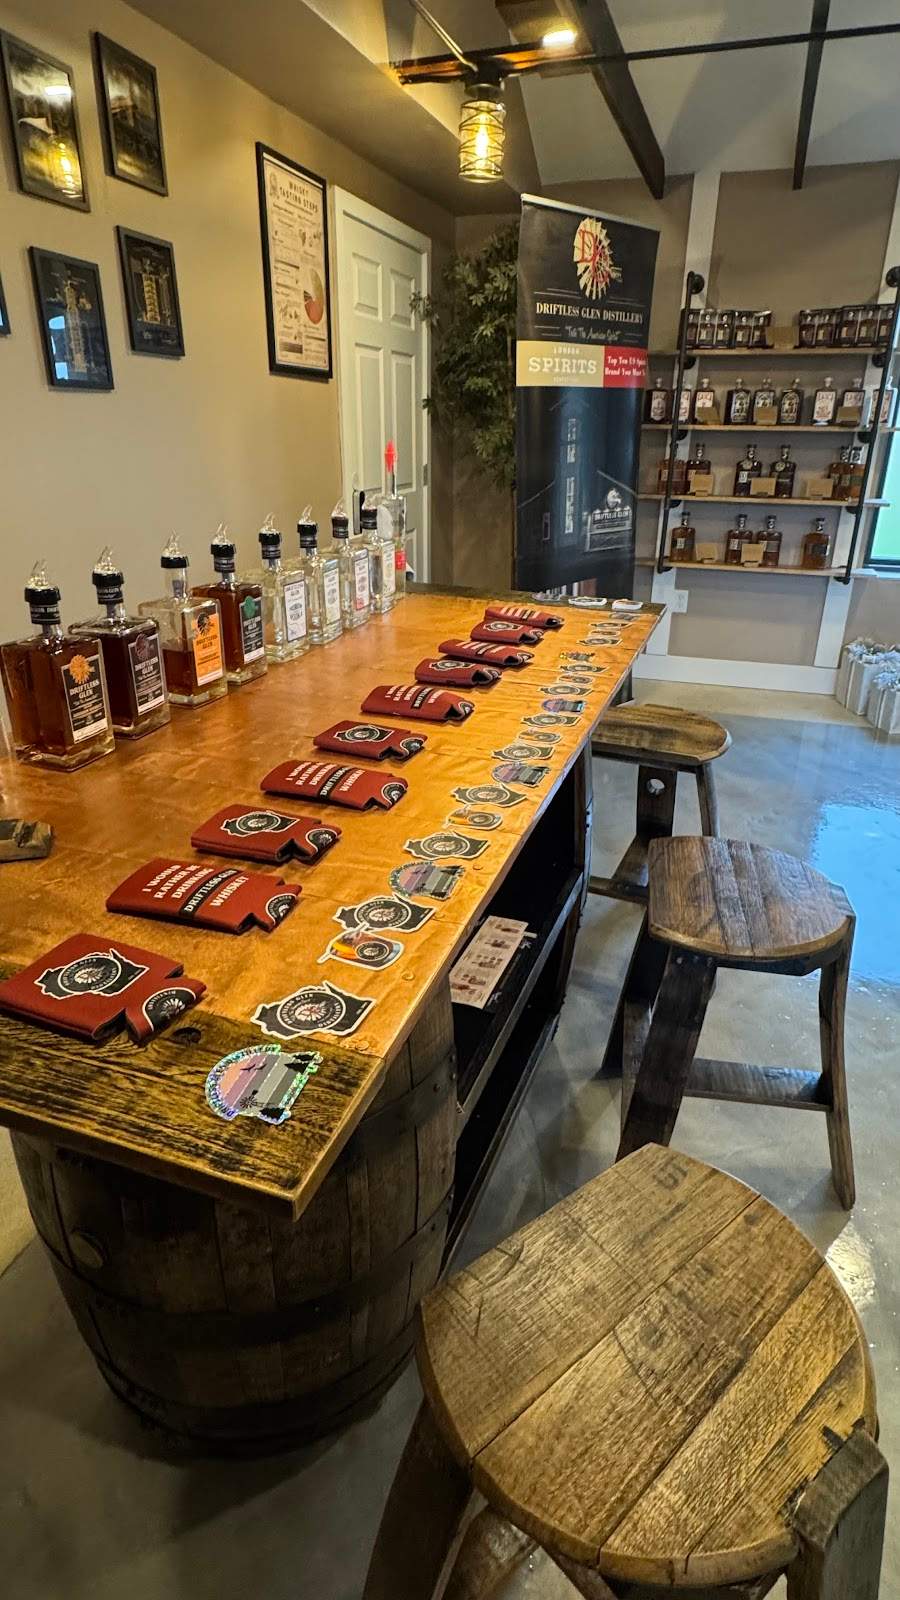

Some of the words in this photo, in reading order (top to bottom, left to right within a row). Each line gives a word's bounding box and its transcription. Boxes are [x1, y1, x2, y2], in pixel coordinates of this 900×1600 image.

[536, 302, 580, 317] DRIFTLESS
[581, 308, 601, 319] GLEN
[602, 310, 643, 324] DISTILLERY
[528, 356, 597, 374] SPIRITS
[608, 356, 618, 366] Top
[69, 679, 100, 696] DRIFTLESS
[78, 689, 93, 699] GLEN
[146, 865, 181, 886] WOULD
[153, 870, 191, 899] RATHER
[171, 868, 214, 898] DRINKING
[183, 877, 222, 912] DRIFTLESS
[209, 876, 249, 907] WHISKEY
